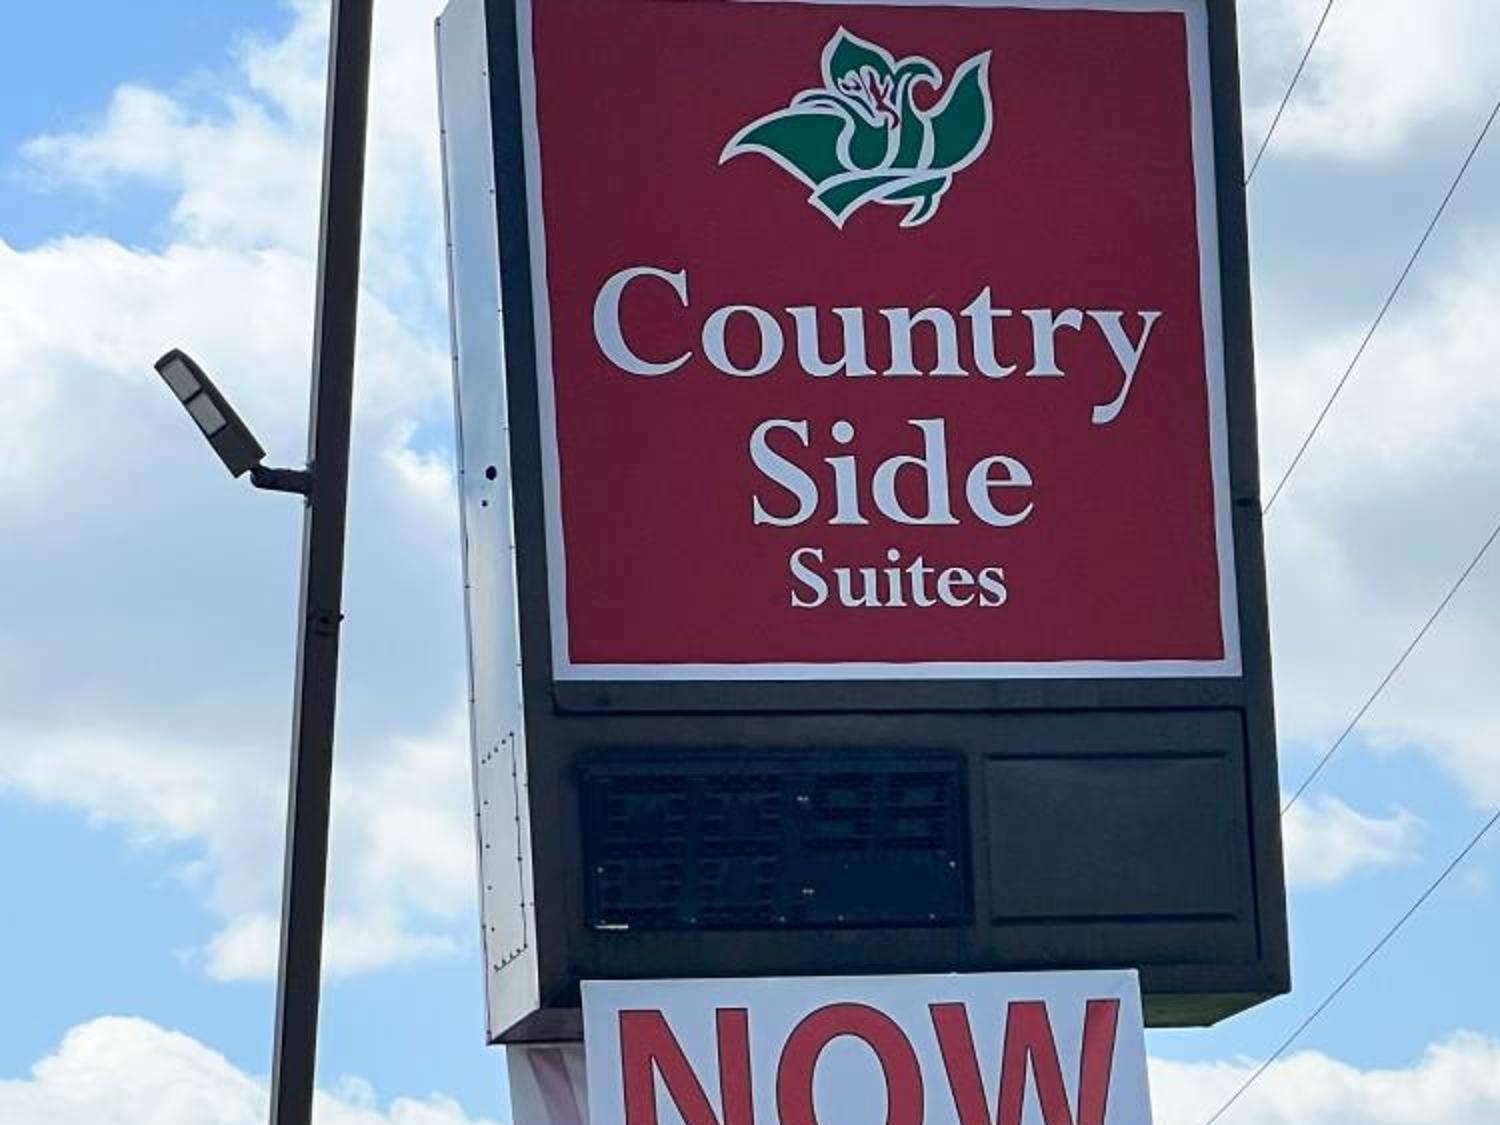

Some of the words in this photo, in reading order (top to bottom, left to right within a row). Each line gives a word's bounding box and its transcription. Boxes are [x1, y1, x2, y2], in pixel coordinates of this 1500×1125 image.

[592, 265, 1162, 425] Country
[748, 417, 1034, 527] Side
[789, 547, 1007, 609] Suites
